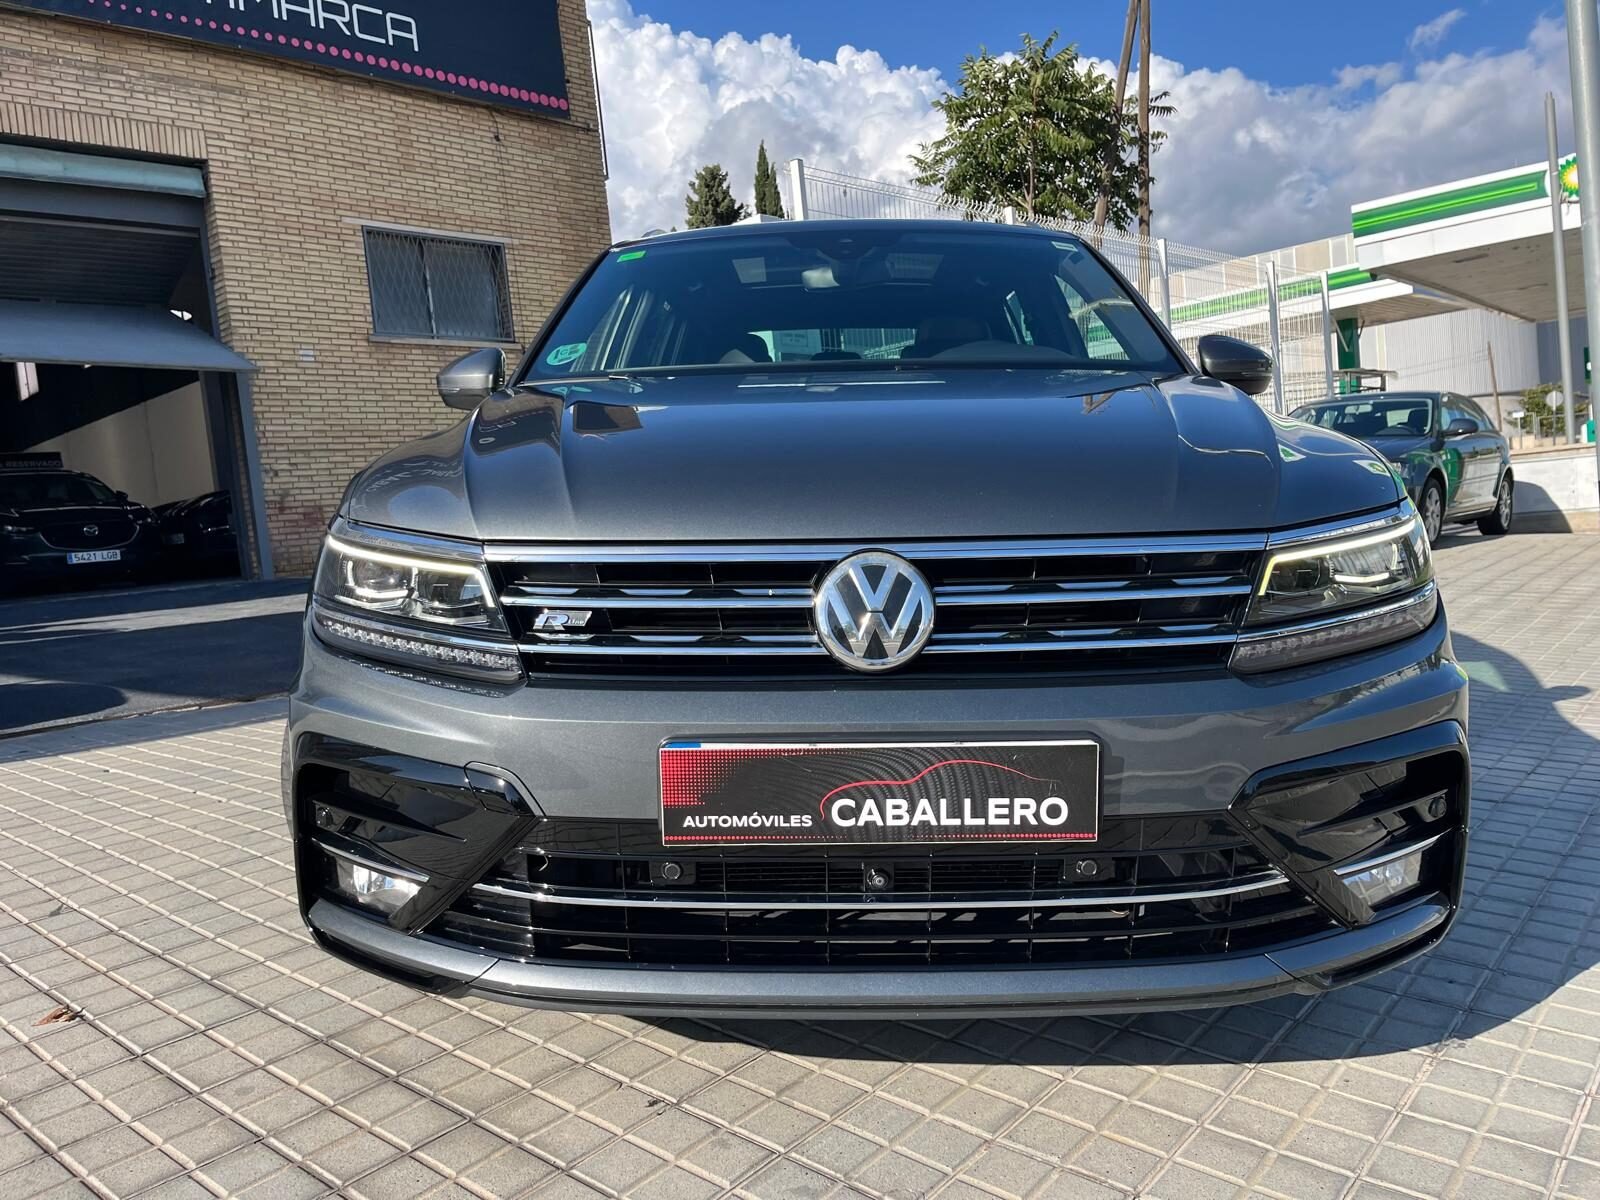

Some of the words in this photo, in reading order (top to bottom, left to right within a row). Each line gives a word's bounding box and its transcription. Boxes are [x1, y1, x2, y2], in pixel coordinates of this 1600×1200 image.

[74, 552, 97, 562] 5421
[683, 812, 813, 829] AUTOMÓVILES
[831, 797, 1069, 827] CABALLERO
